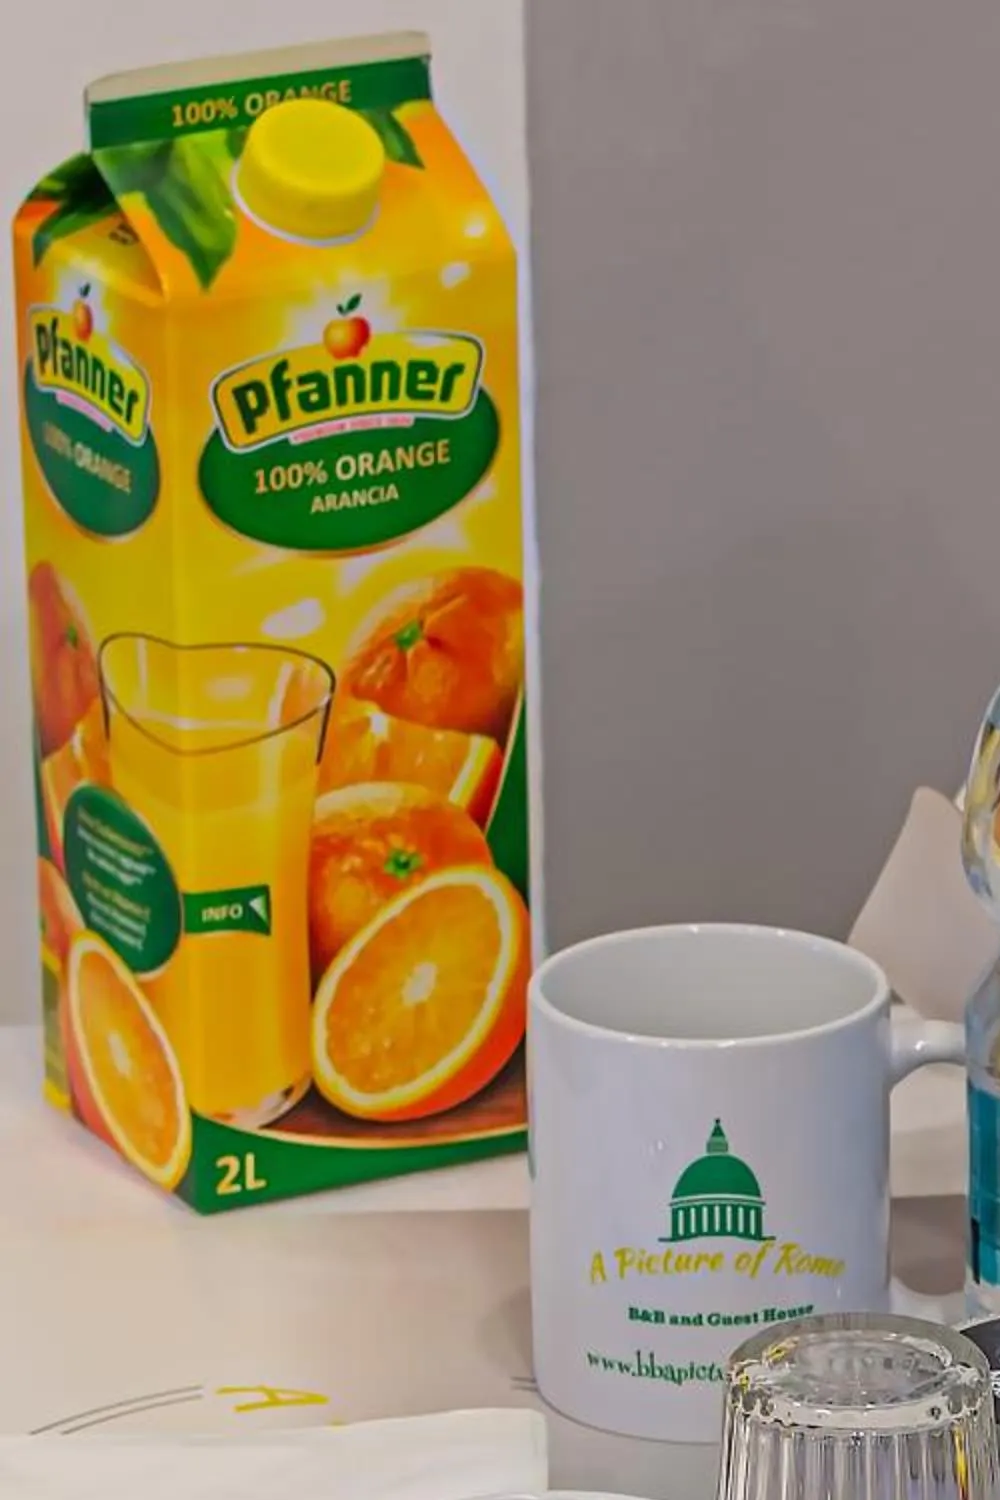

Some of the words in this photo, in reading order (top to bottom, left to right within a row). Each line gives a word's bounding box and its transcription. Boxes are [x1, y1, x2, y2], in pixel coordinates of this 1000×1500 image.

[172, 95, 238, 127] 100%
[254, 460, 329, 494] 100%
[335, 439, 451, 481] ORANGE
[310, 483, 399, 514] ARANCIA
[201, 902, 244, 923] INFO
[215, 1152, 267, 1197] 2L
[590, 1250, 607, 1285] A
[614, 1246, 725, 1280] Picture
[733, 1238, 775, 1279] of
[628, 1307, 665, 1324] B&B
[669, 1313, 703, 1326] and
[707, 1313, 759, 1326] Guest
[762, 1303, 814, 1323] House
